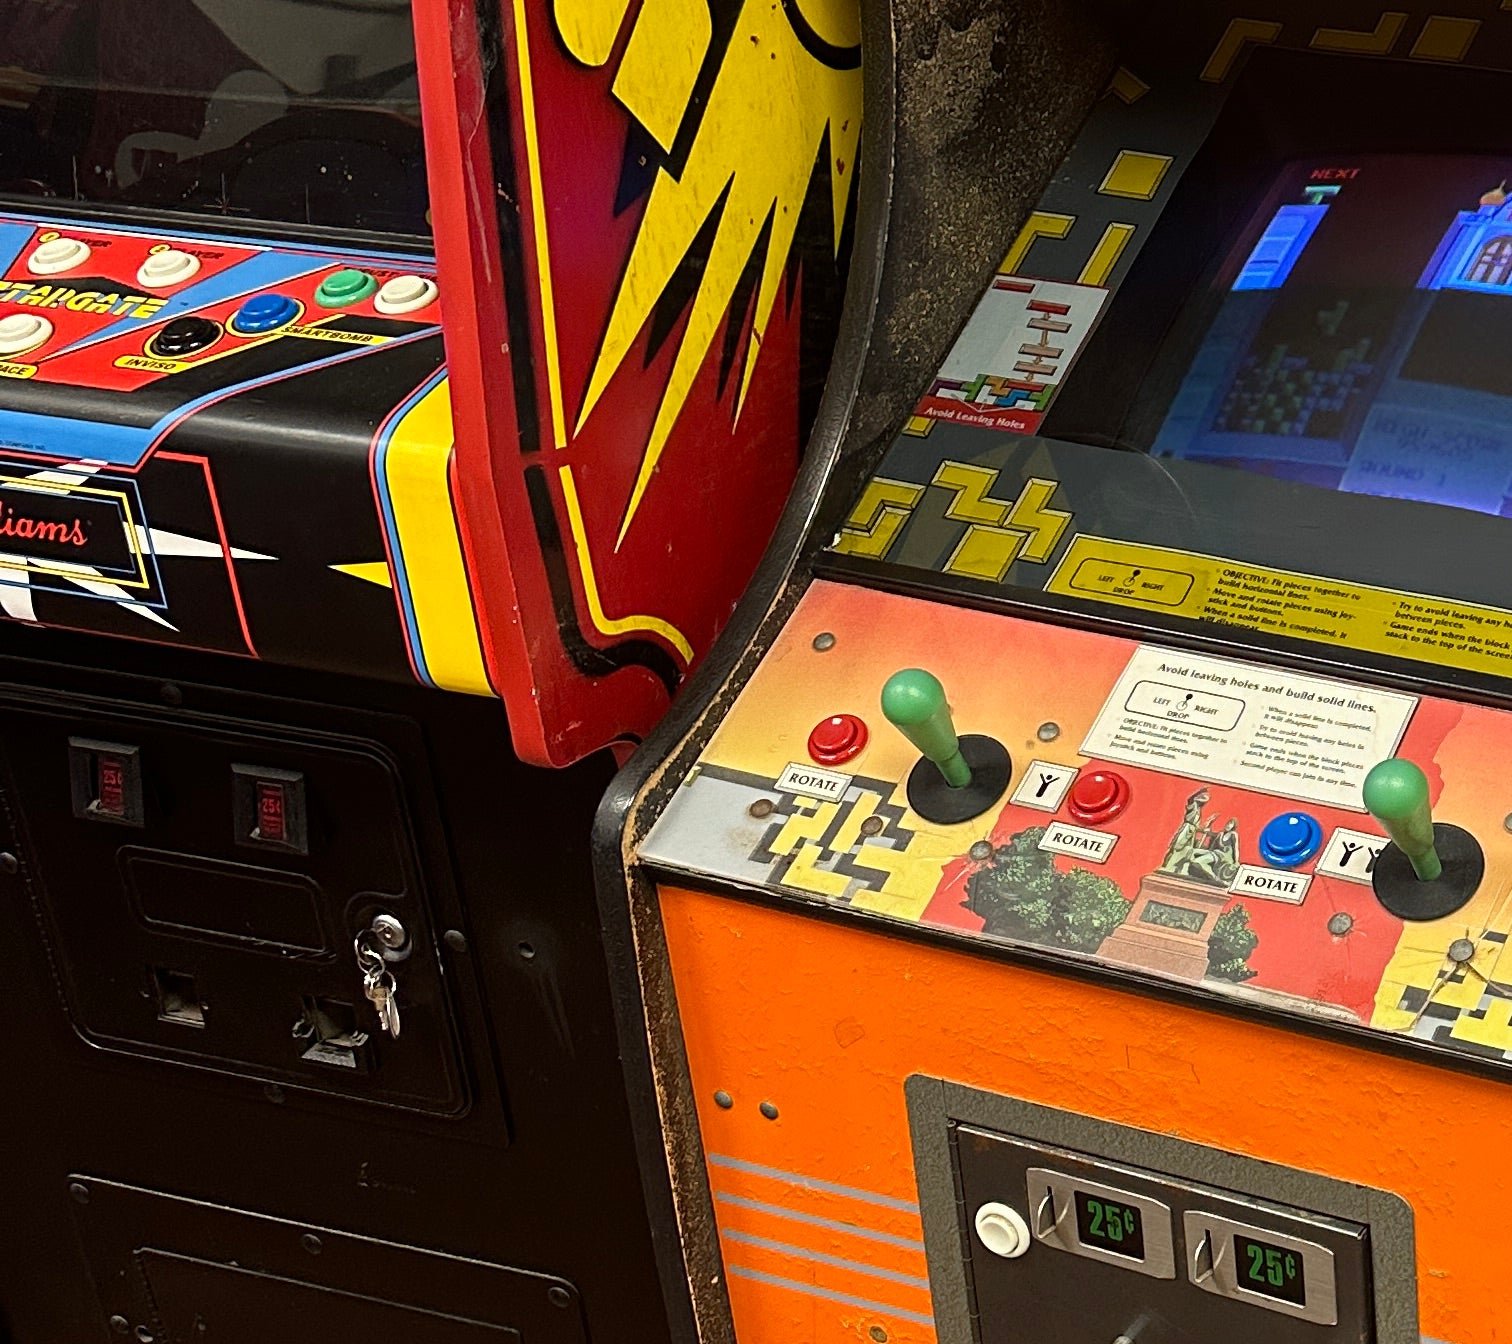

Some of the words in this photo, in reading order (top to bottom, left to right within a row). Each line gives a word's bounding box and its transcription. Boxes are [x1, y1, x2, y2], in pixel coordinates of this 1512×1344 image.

[1311, 167, 1361, 181] NEXT
[282, 326, 374, 344] SMARTBOMB
[125, 357, 178, 371] INVISO
[924, 407, 955, 419] Avoid
[956, 412, 994, 427] Leaving
[996, 417, 1026, 430] Holes
[1097, 575, 1116, 583] LEFT
[1141, 581, 1165, 591] RIGHT
[1113, 587, 1134, 596] DROP
[1218, 578, 1241, 589] build
[1242, 583, 1286, 597] horizontal
[1287, 591, 1310, 601] lines.
[1222, 568, 1269, 585] OBJECTIVE:
[1284, 581, 1312, 593] pieces
[1314, 585, 1350, 600] together
[1351, 593, 1362, 601] to
[1208, 597, 1229, 606] stick
[1230, 601, 1248, 610] and
[1249, 605, 1285, 616] buttons.
[1212, 587, 1237, 599] Move
[1238, 593, 1256, 602] and
[1256, 597, 1283, 607] rotate
[1284, 602, 1312, 614] pieces
[1314, 607, 1338, 619] using
[1399, 601, 1412, 612] Try
[1413, 604, 1424, 612] to
[1425, 606, 1450, 617] avoid
[1451, 611, 1484, 625] leaving
[1484, 617, 1502, 627] any
[1203, 606, 1229, 617] When
[1237, 613, 1260, 624] solid
[1260, 616, 1278, 626] line
[1279, 620, 1288, 628] is
[1394, 611, 1433, 624] between
[1434, 618, 1467, 630] pieces.
[1384, 630, 1409, 641] stack
[1410, 635, 1421, 643] to
[1421, 637, 1437, 646] the
[1438, 640, 1455, 650] top
[1456, 642, 1468, 651] of
[1468, 644, 1484, 654] the
[1390, 621, 1415, 632] Game
[1416, 626, 1439, 636] ends
[1441, 630, 1466, 641] when
[1467, 634, 1483, 644] the
[1484, 638, 1510, 650] block
[1157, 663, 1189, 678] Avoid
[1190, 668, 1228, 686] leaving
[1230, 676, 1260, 690] holes
[1262, 684, 1283, 695] and
[1286, 688, 1315, 703] build
[1316, 693, 1346, 708] solid
[1347, 699, 1377, 713] lines.
[1152, 696, 1172, 707] LEFT
[1194, 704, 1219, 716] RIGHT
[788, 771, 840, 793] ROTATE
[1052, 832, 1105, 854] ROTATE
[1244, 874, 1299, 895] ROTATE
[1087, 1199, 1136, 1242] 25¢
[1247, 1244, 1297, 1288] 25¢
